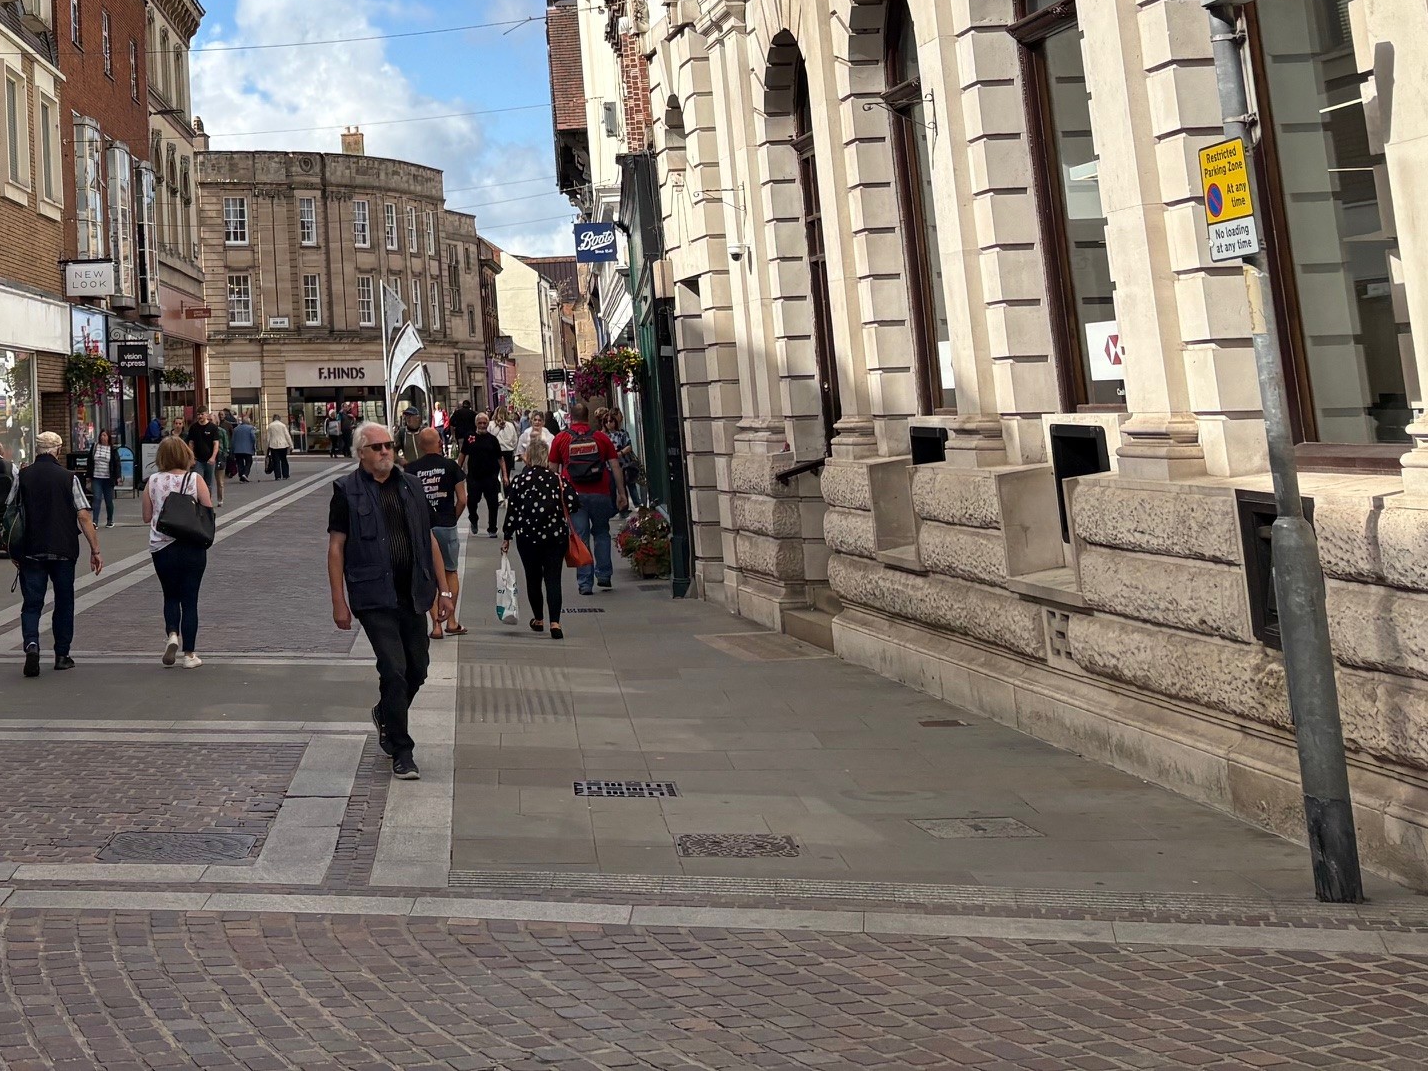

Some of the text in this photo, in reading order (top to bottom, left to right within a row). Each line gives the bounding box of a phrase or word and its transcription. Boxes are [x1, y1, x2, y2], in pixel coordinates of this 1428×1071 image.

[1206, 145, 1237, 164] Restricted
[1204, 160, 1243, 179] Parking Zone
[1227, 182, 1247, 194] At any
[1231, 197, 1246, 208] time
[1215, 224, 1250, 240] No loading
[578, 230, 614, 251] Boots
[1216, 238, 1252, 254] at any time
[74, 270, 104, 279] NEW
[72, 280, 107, 289] LOOK
[123, 352, 142, 360] vision
[120, 360, 146, 368] express
[318, 367, 365, 380] F.HINDS
